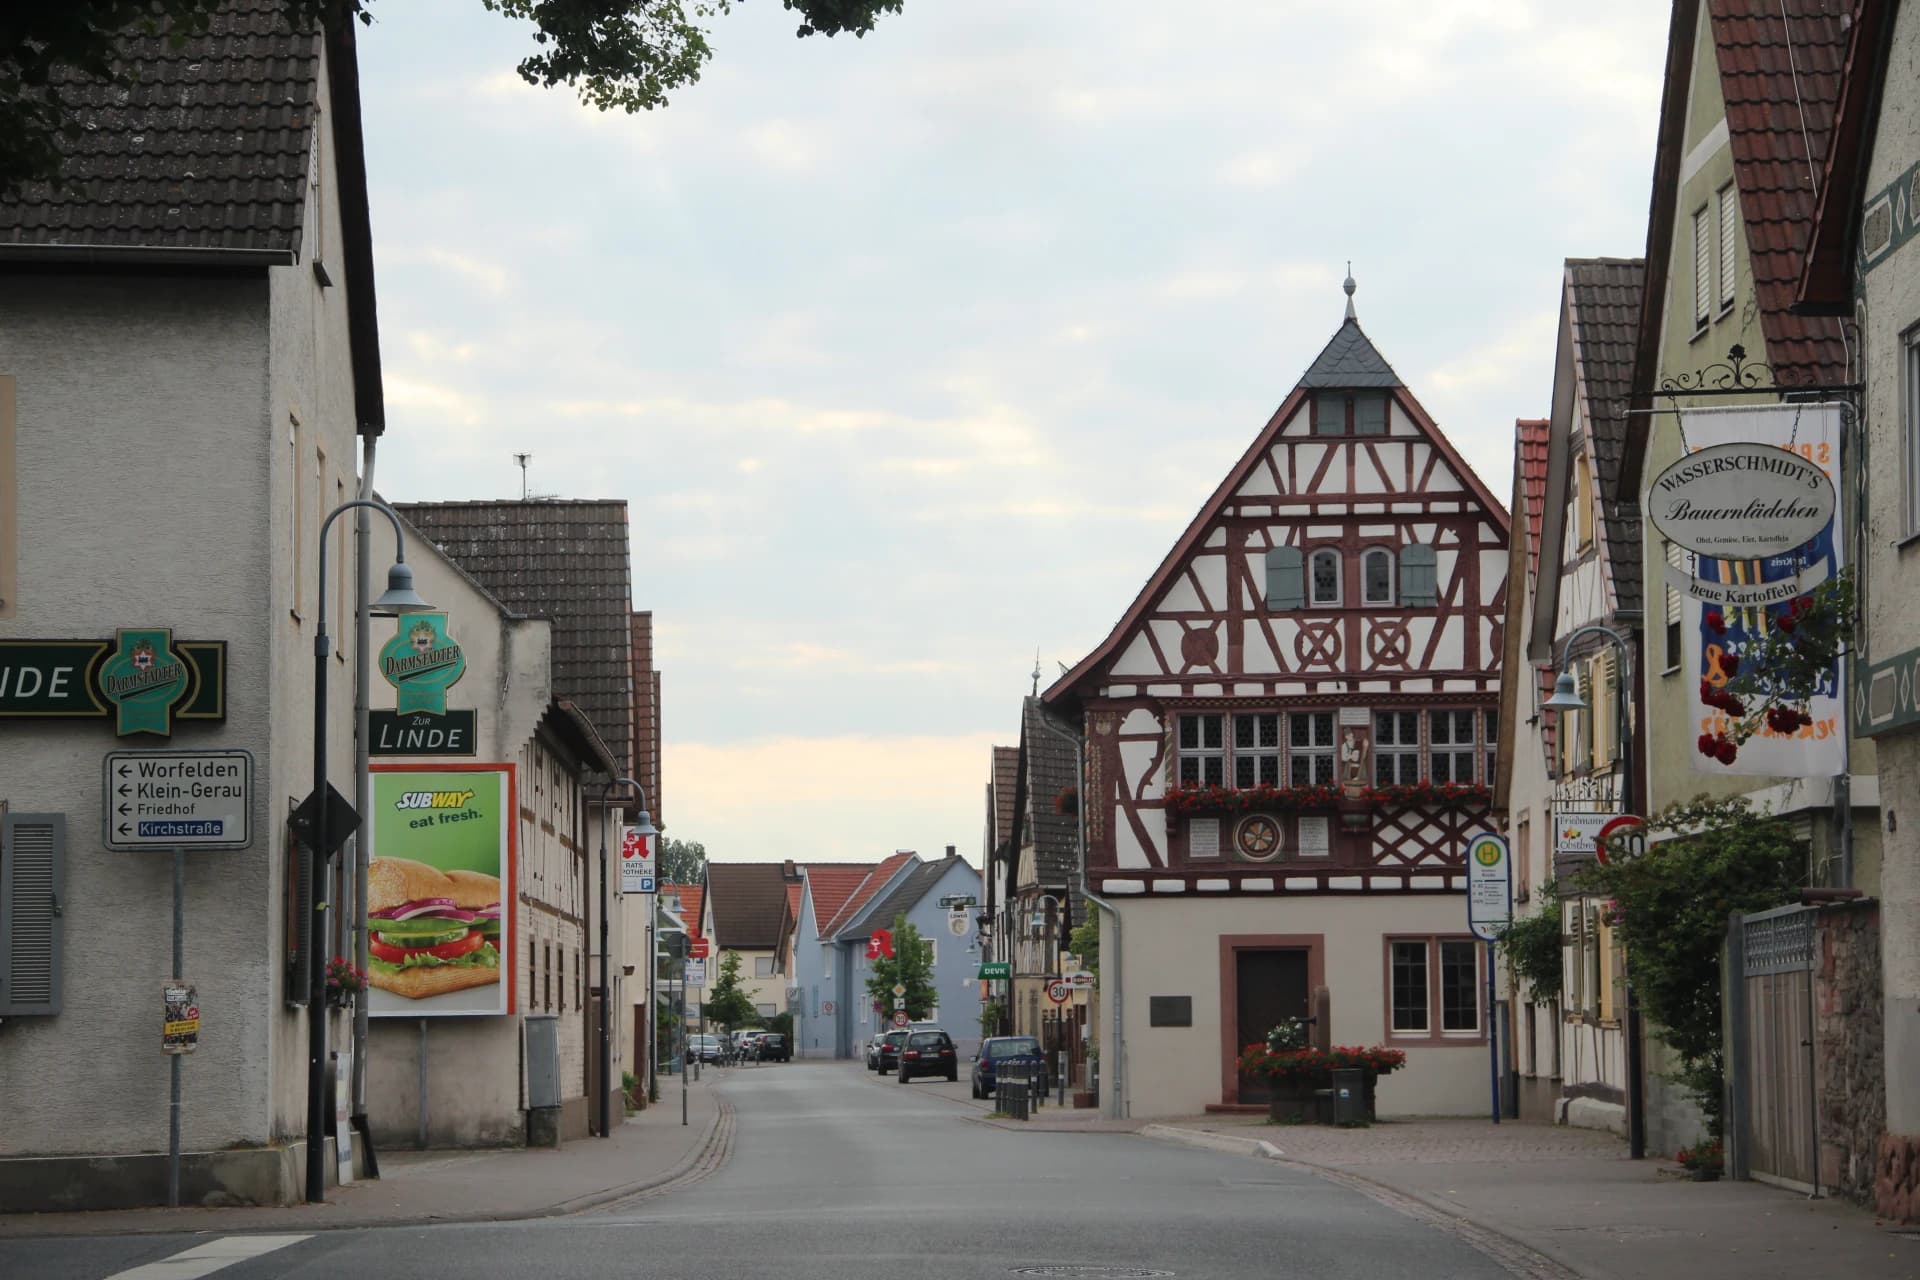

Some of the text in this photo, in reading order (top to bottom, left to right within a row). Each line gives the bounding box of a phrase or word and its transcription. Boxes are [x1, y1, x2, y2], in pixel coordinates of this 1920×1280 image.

[1659, 455, 1824, 494] WASSERSCHMIDT'S
[1664, 497, 1820, 522] Bauernlädchen
[1689, 580, 1798, 604] neue Kartoffeln
[412, 716, 431, 726] ZUR
[379, 723, 463, 748] LINDE
[138, 761, 239, 777] Worfelden
[138, 783, 242, 799] Klein-Gerau
[395, 787, 476, 812] SUBWAY
[138, 803, 196, 815] Friedhof
[410, 808, 484, 829] eat fresh.
[140, 821, 223, 836] Kirchstraße
[984, 967, 1006, 975] DEVK
[1053, 986, 1065, 998] 30
